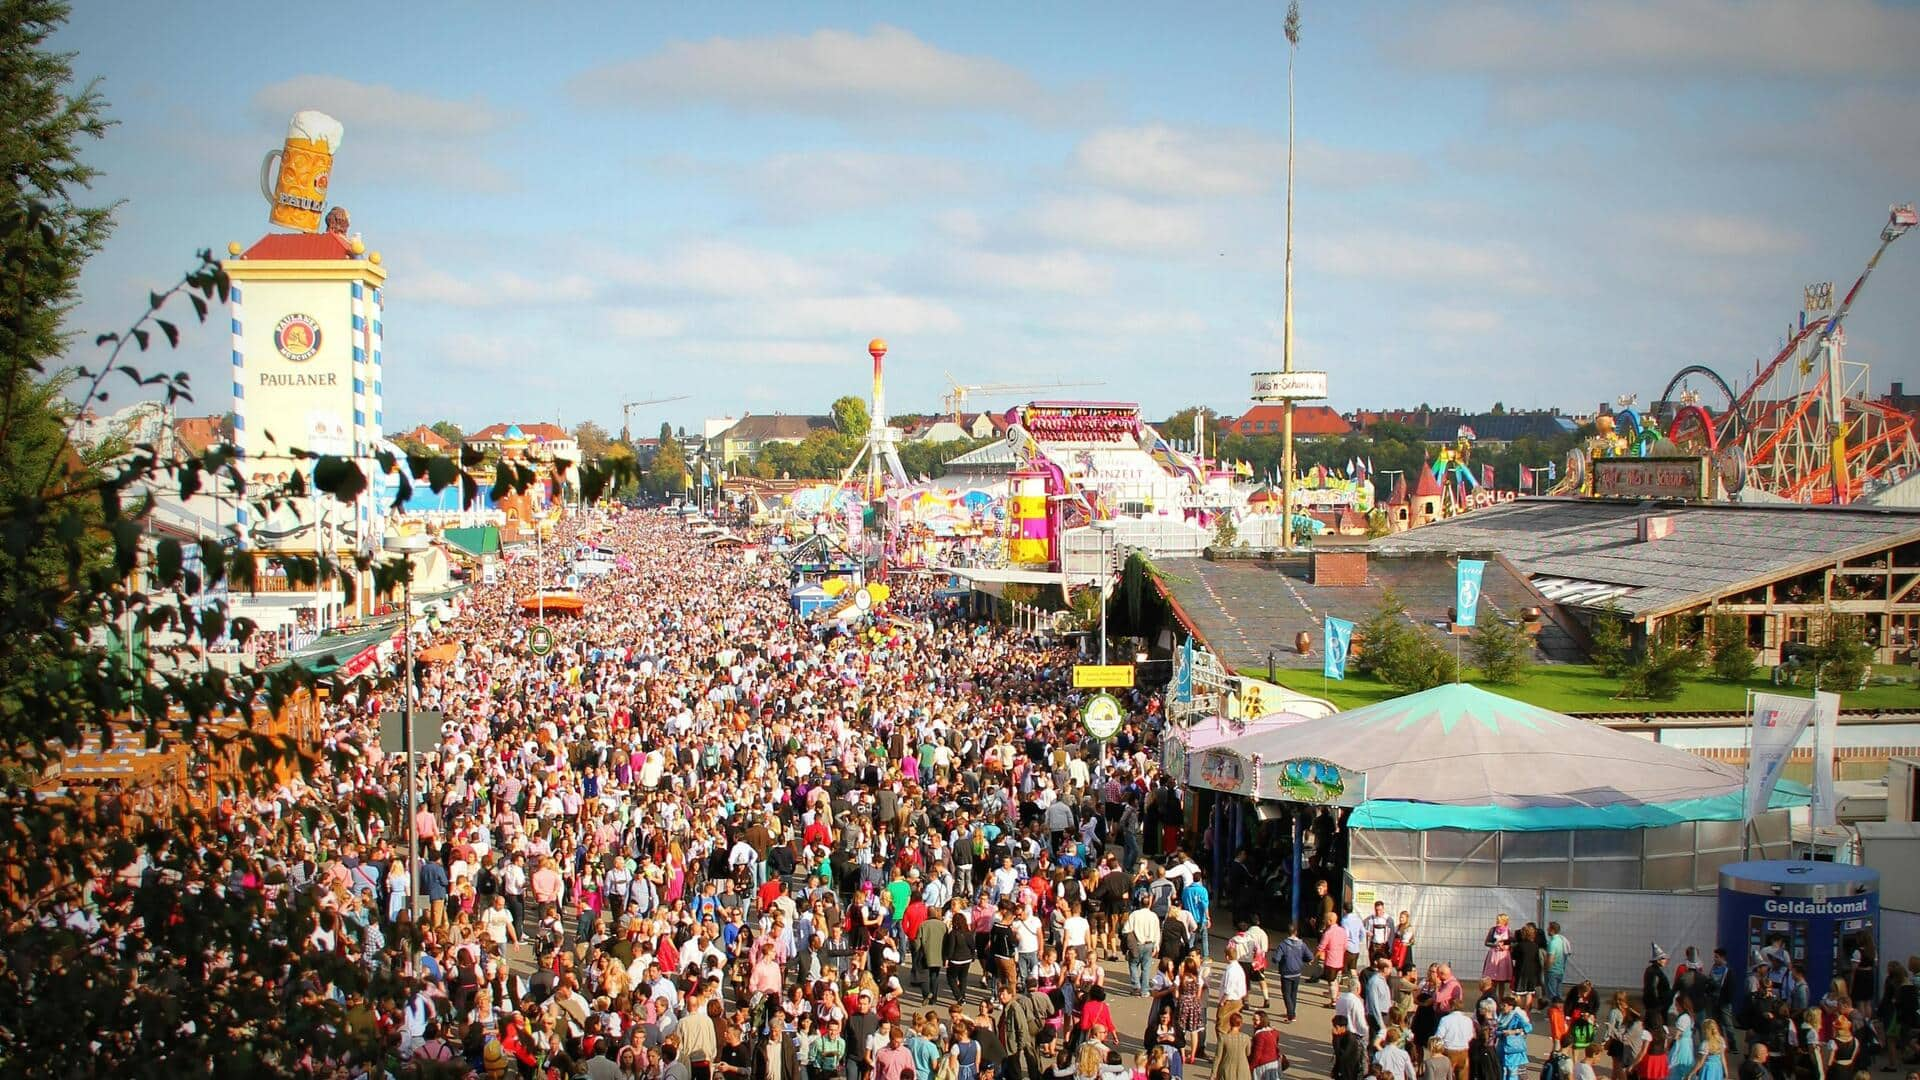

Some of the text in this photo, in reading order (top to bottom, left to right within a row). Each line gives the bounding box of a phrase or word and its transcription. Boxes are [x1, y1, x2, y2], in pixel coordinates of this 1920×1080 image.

[276, 313, 320, 332] PAULANER
[260, 372, 337, 386] PAULANER
[1765, 899, 1867, 914] Geldautomat
